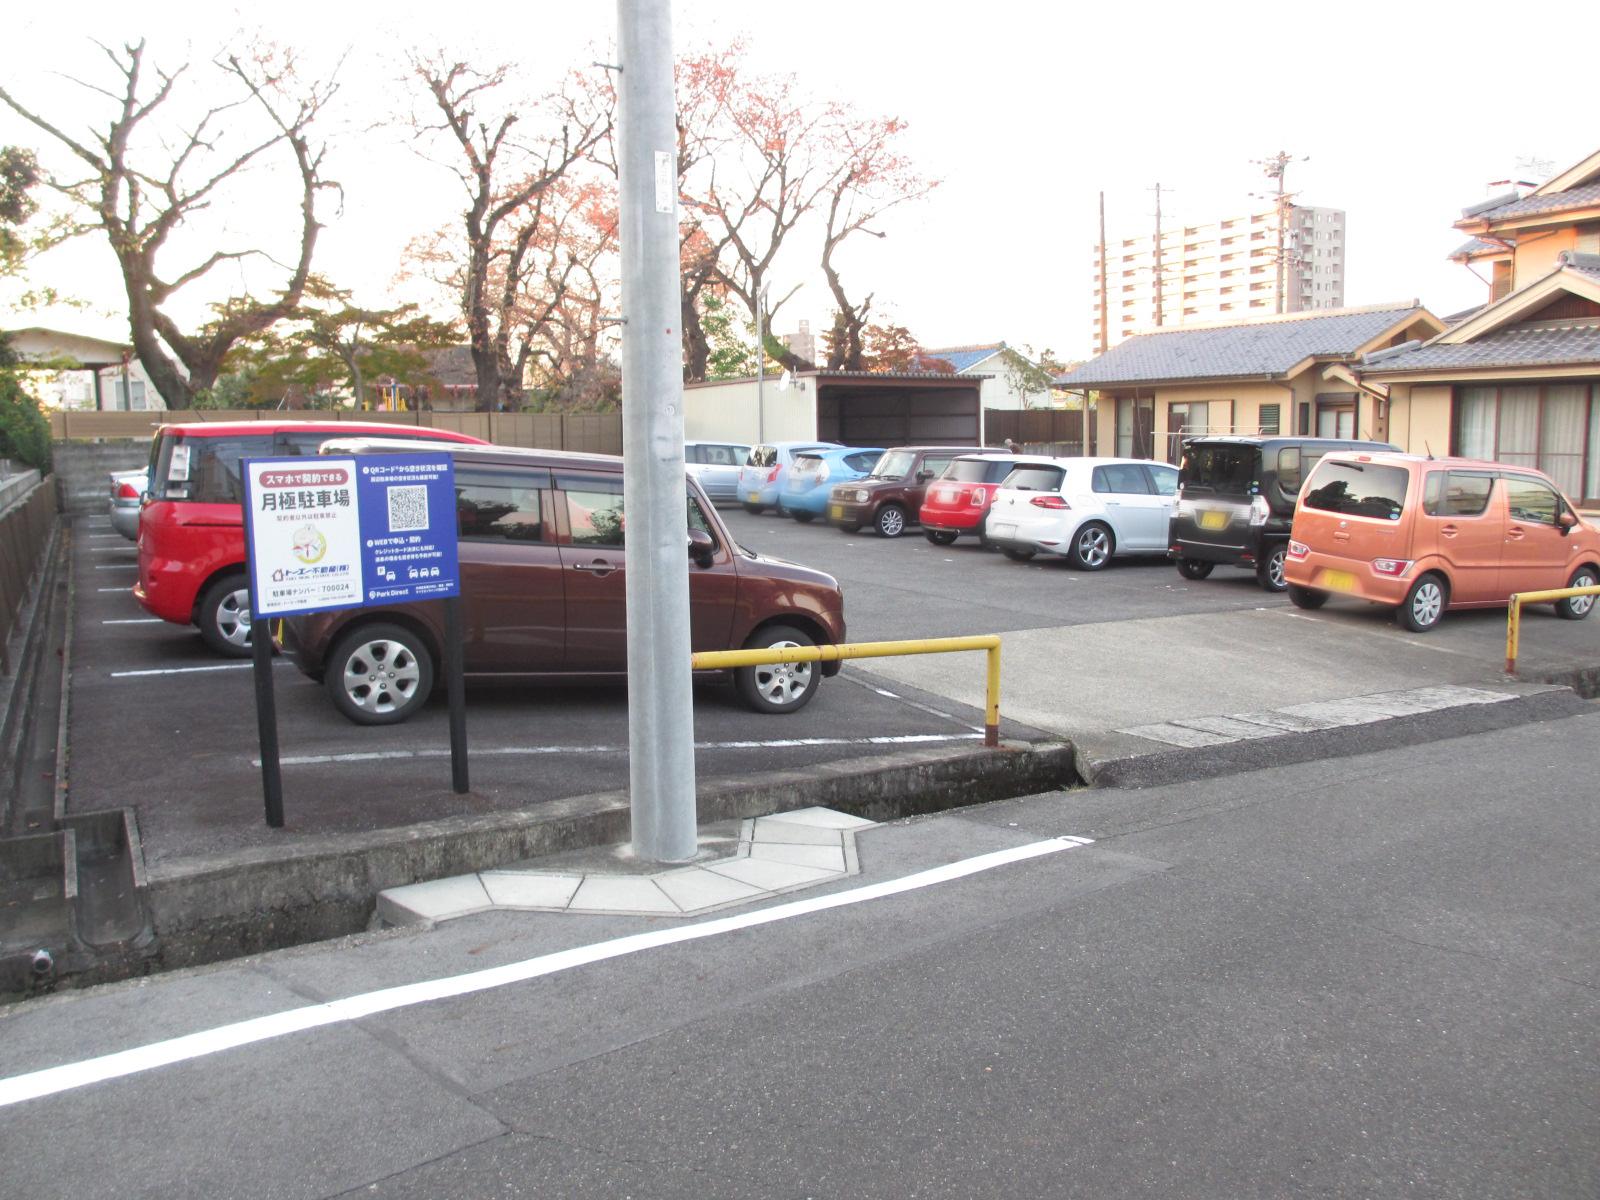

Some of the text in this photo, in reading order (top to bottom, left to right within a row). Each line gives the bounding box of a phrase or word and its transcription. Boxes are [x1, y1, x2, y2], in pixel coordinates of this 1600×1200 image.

[266, 473, 343, 485] スマホで契約できる
[262, 489, 350, 511] 月極駐車場
[376, 590, 390, 598] Park
[390, 588, 409, 596] Direct
